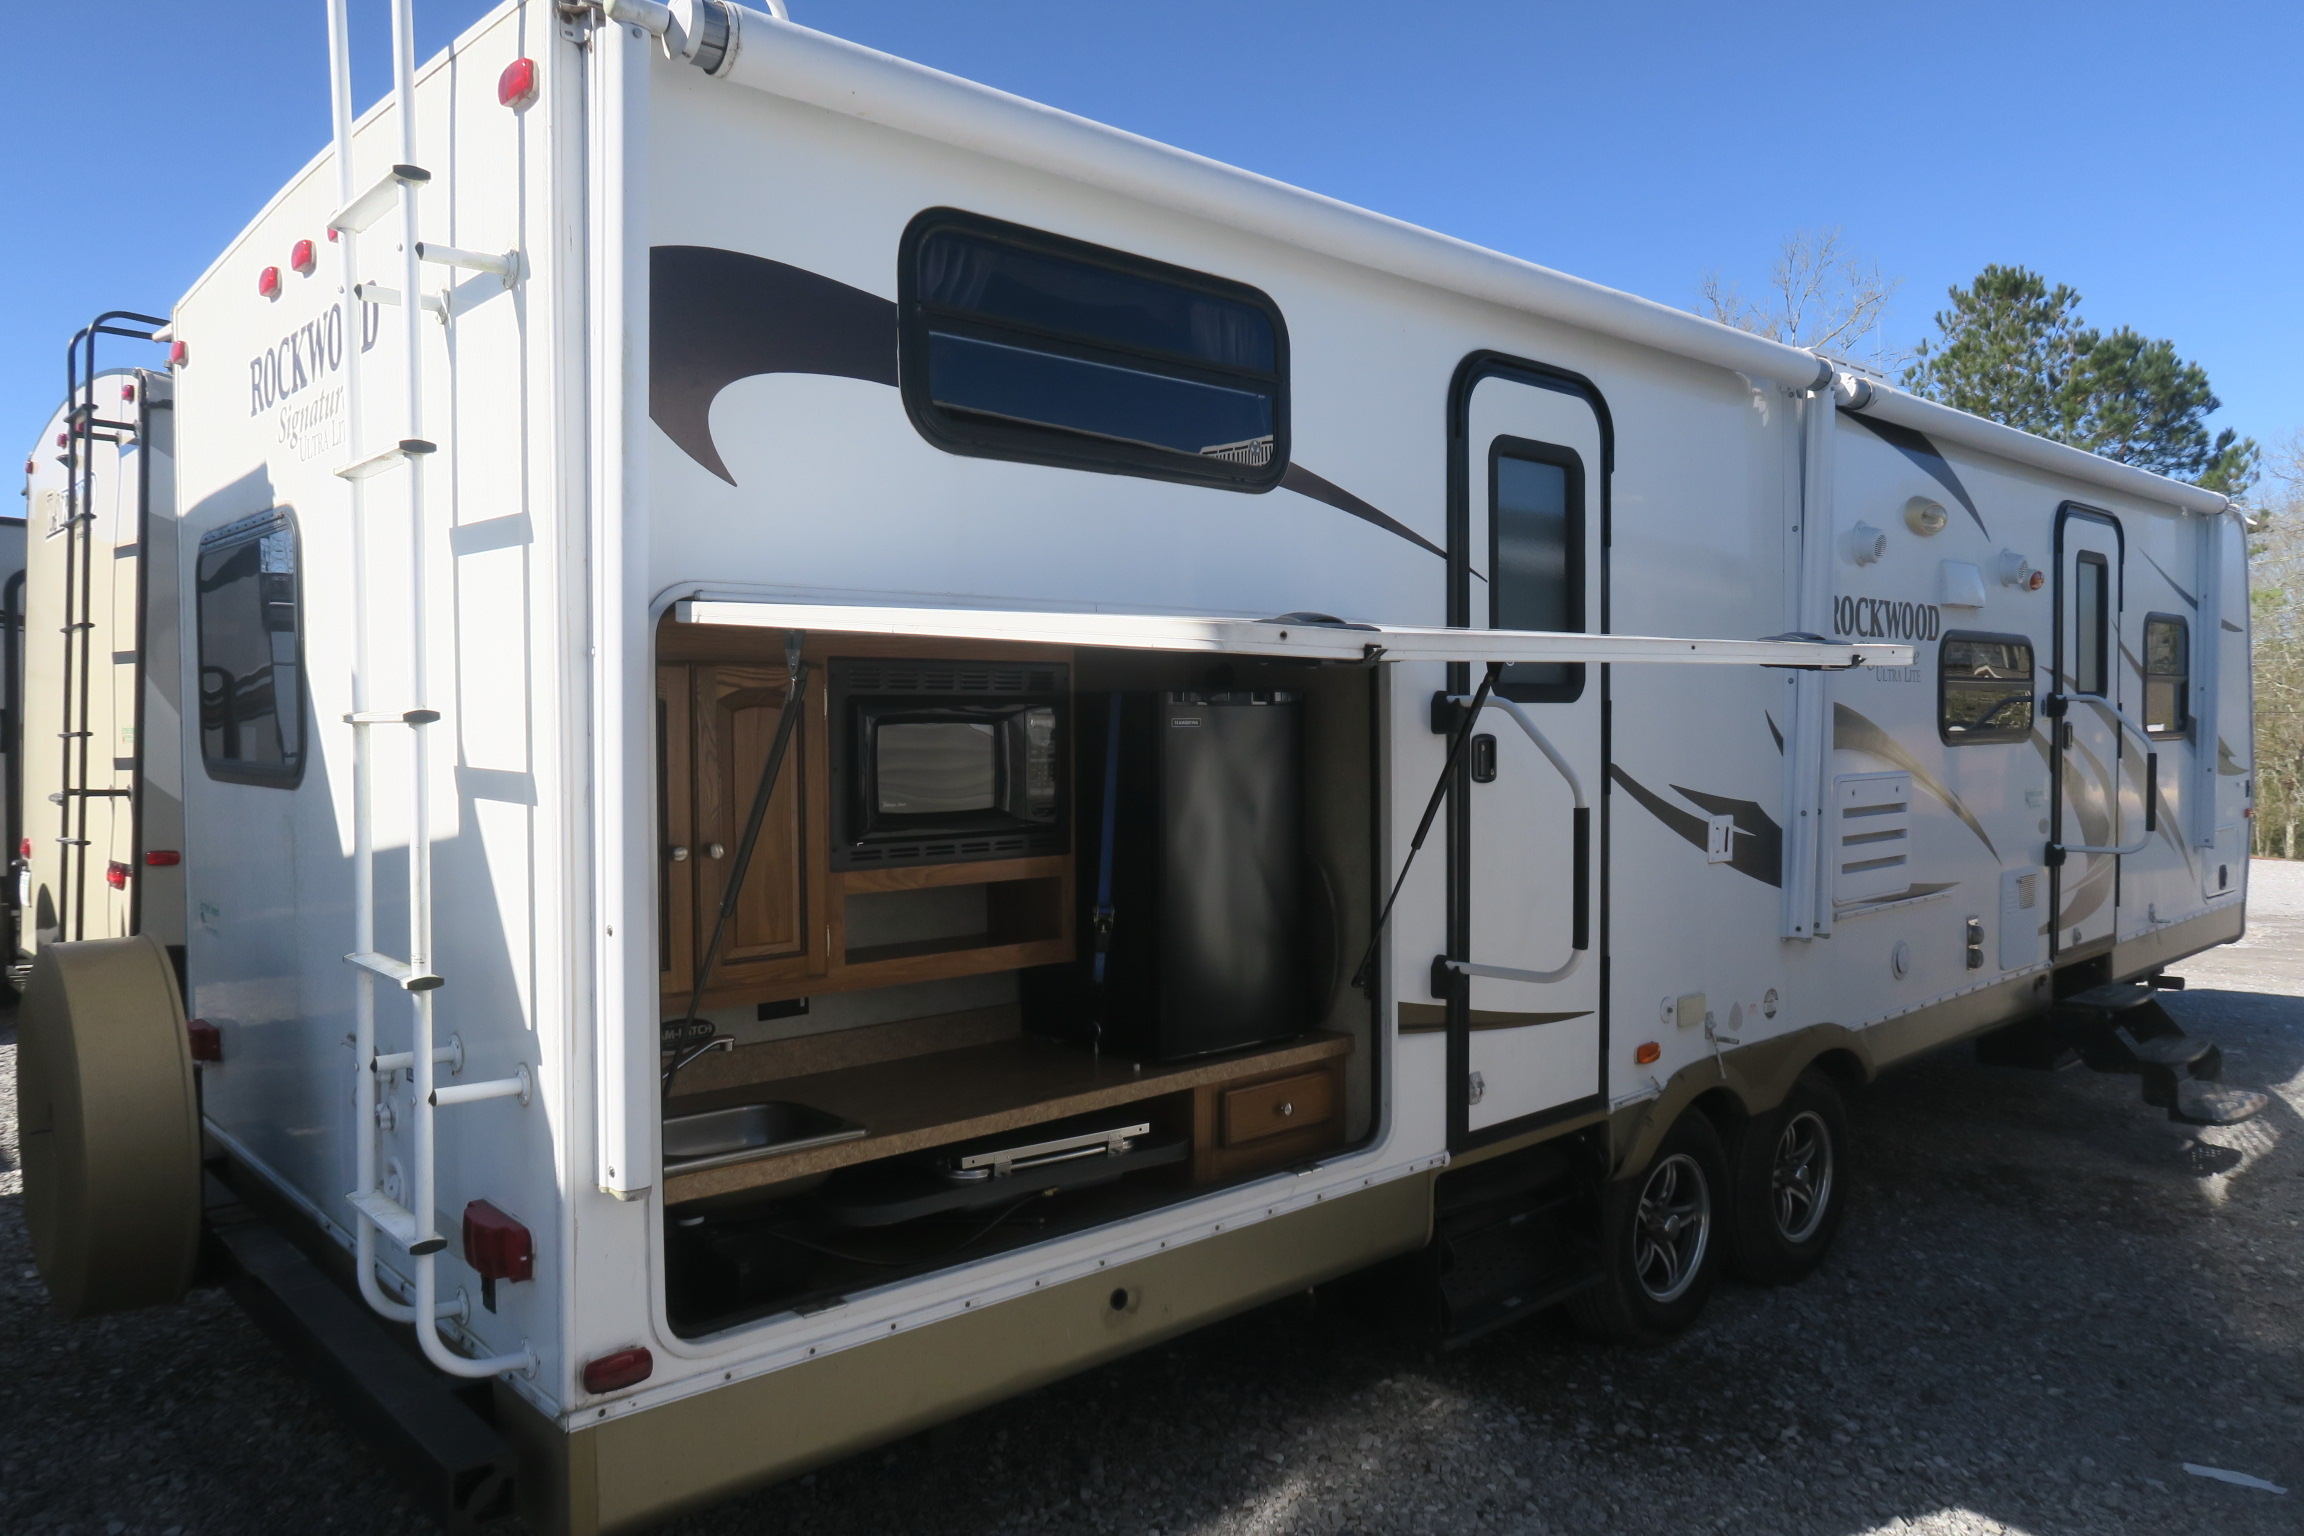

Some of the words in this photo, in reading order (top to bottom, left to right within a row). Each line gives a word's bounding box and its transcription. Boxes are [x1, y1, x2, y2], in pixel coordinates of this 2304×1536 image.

[250, 279, 379, 418] ROCKWOD
[278, 384, 345, 450] Signatur
[331, 418, 346, 447] LIT
[1833, 594, 1940, 642] ROCKWOOD
